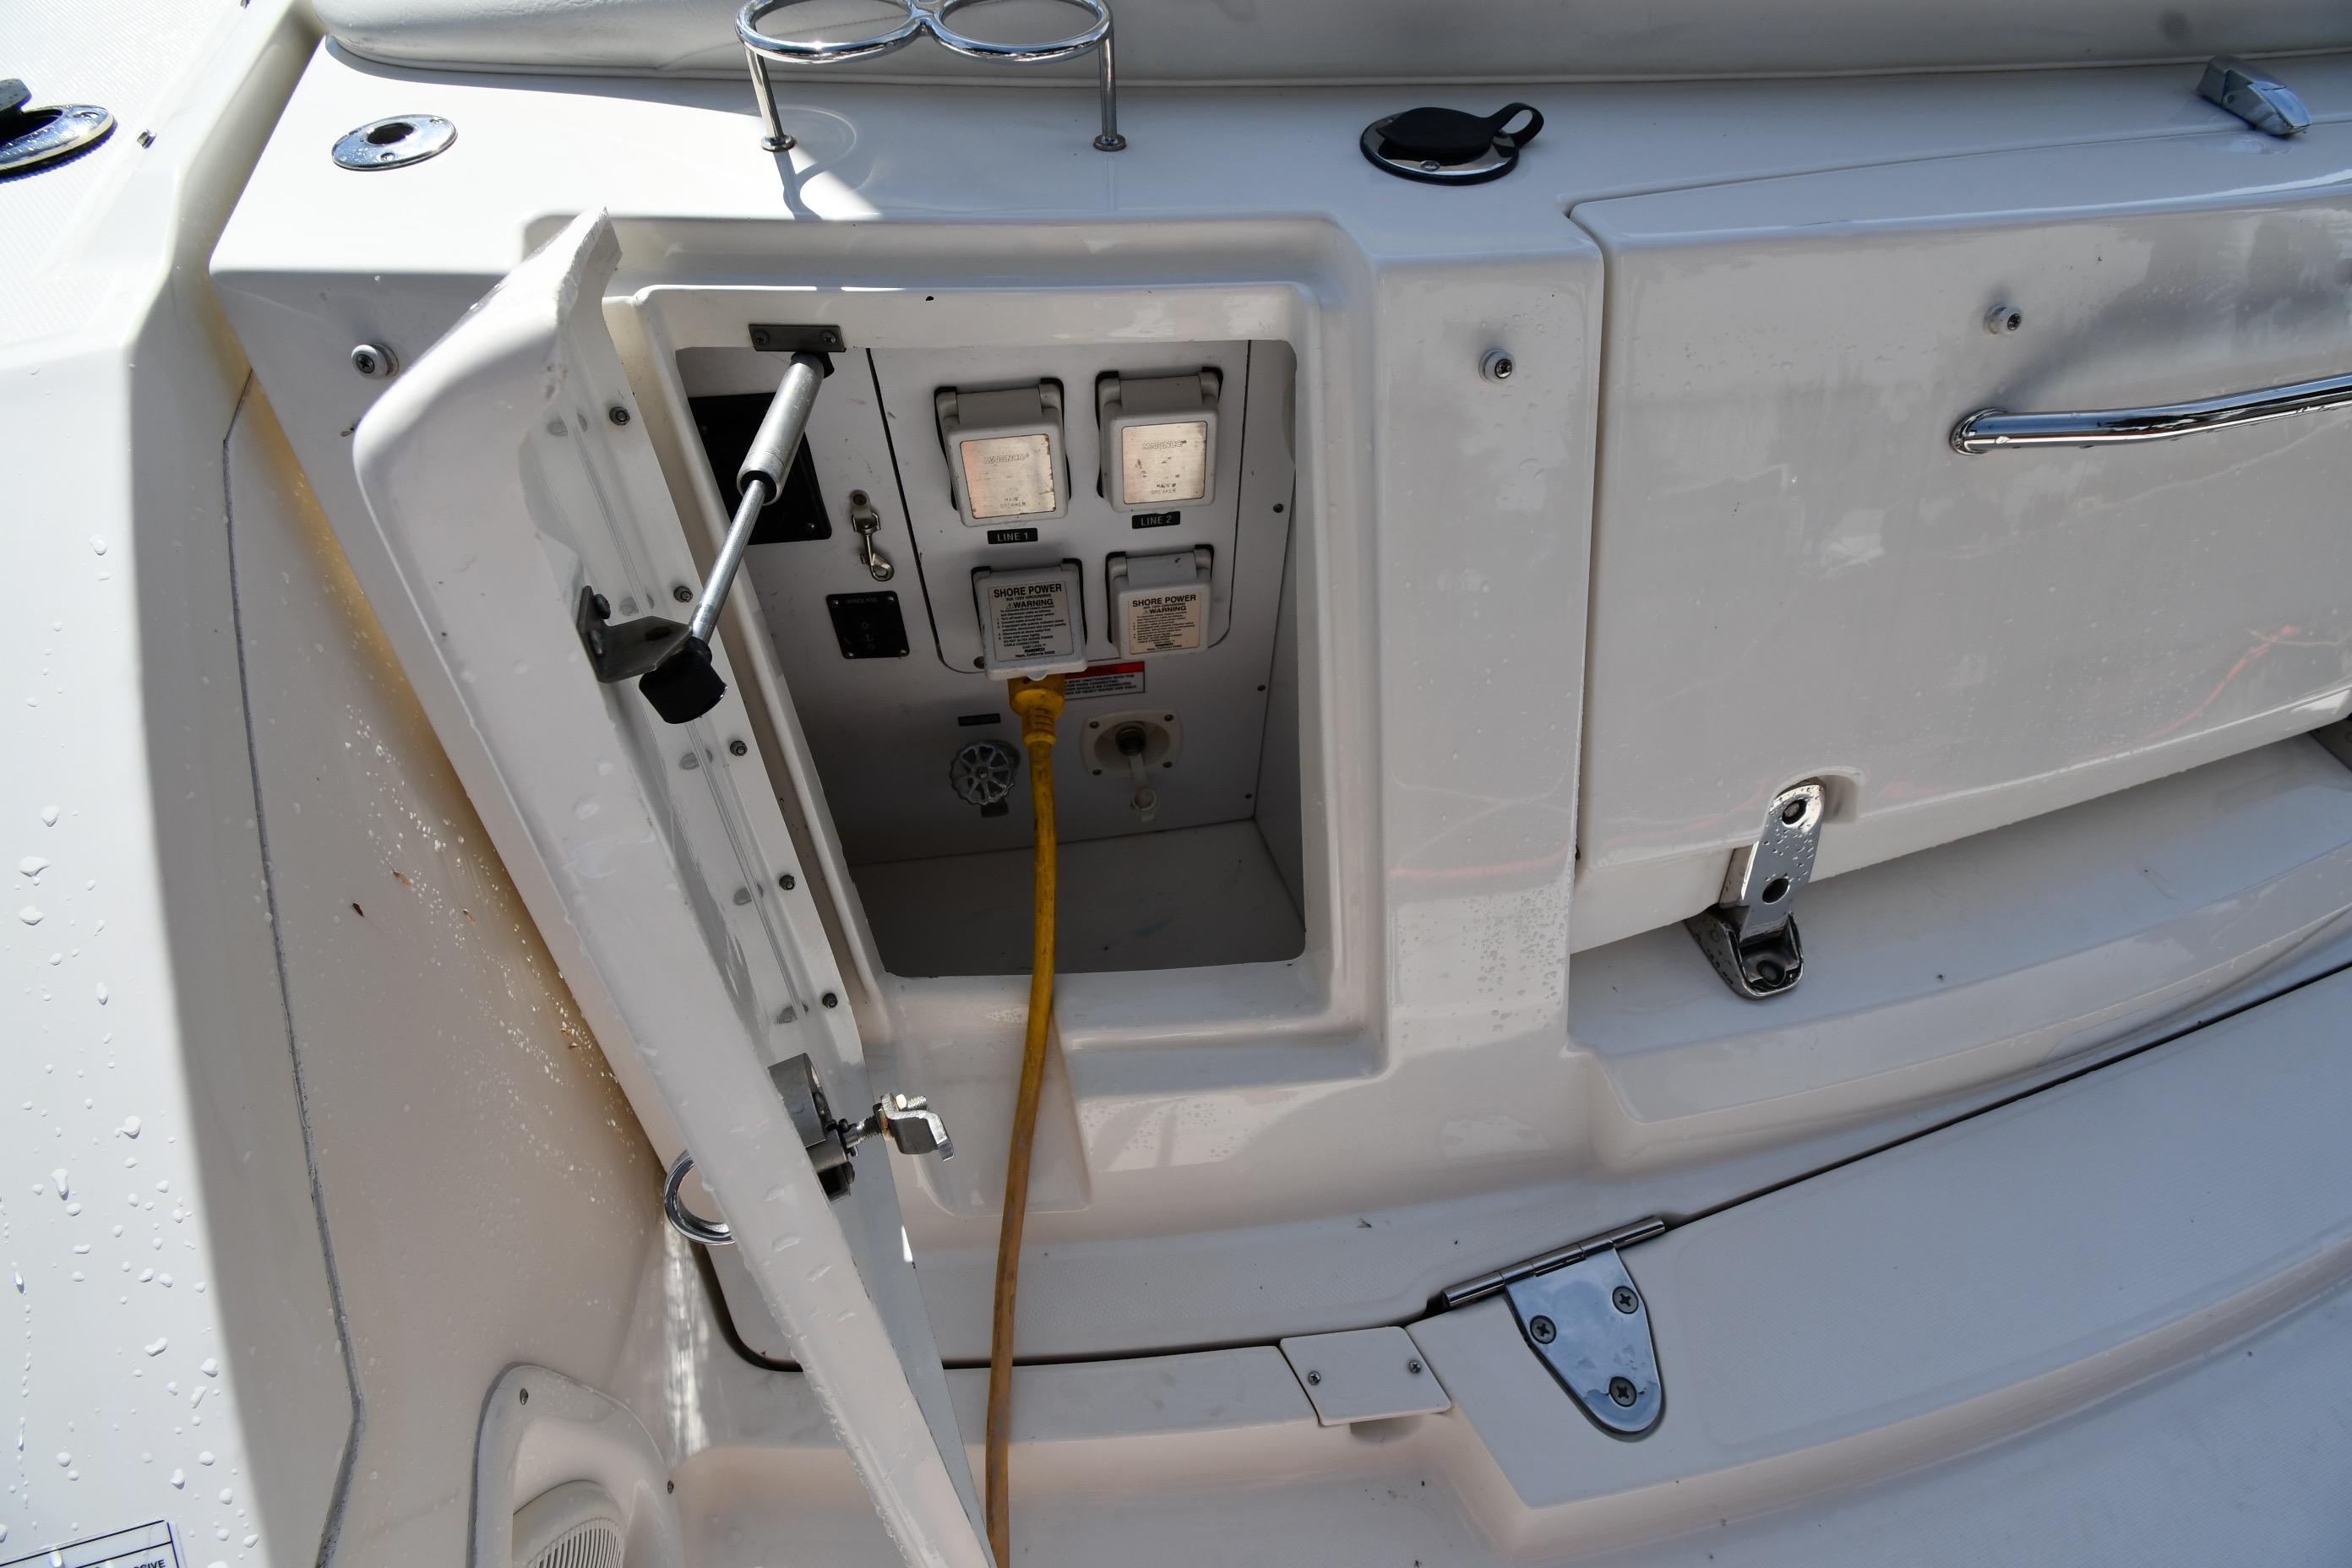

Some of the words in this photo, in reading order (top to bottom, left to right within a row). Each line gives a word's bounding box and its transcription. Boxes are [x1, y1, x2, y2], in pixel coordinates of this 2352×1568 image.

[1141, 515, 1162, 525] LINE
[1166, 514, 1172, 523] 2
[997, 532, 1020, 542] LINE
[1023, 532, 1028, 541] 1
[994, 586, 1026, 598] SHORE
[1028, 583, 1062, 595] POWER
[1013, 598, 1054, 608] WARNING
[1132, 597, 1162, 607] SHORE
[1165, 594, 1196, 603] POWER
[1149, 605, 1187, 614] WARNING
